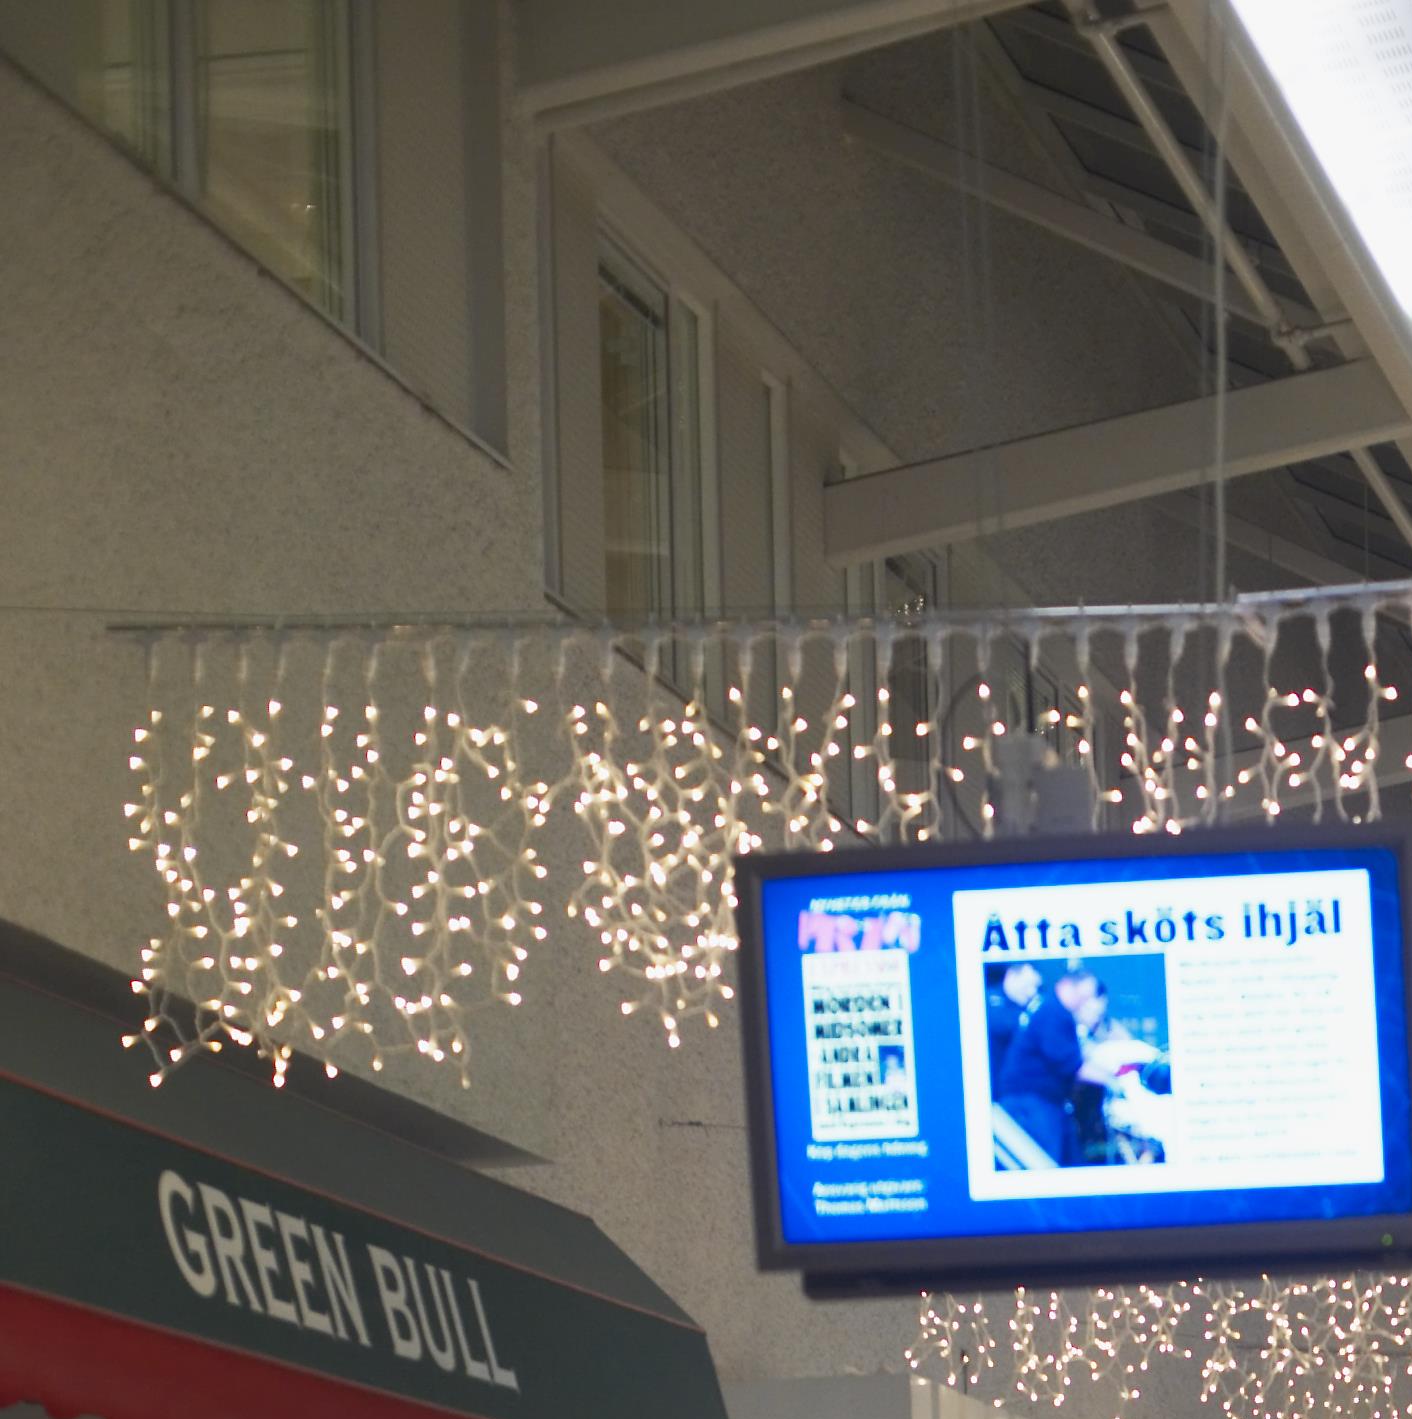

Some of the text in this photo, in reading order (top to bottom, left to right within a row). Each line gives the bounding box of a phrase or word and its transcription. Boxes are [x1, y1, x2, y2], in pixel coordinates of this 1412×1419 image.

[982, 898, 1342, 952] Åtta sköts ihjäl
[157, 1168, 521, 1393] GREEN BULL
